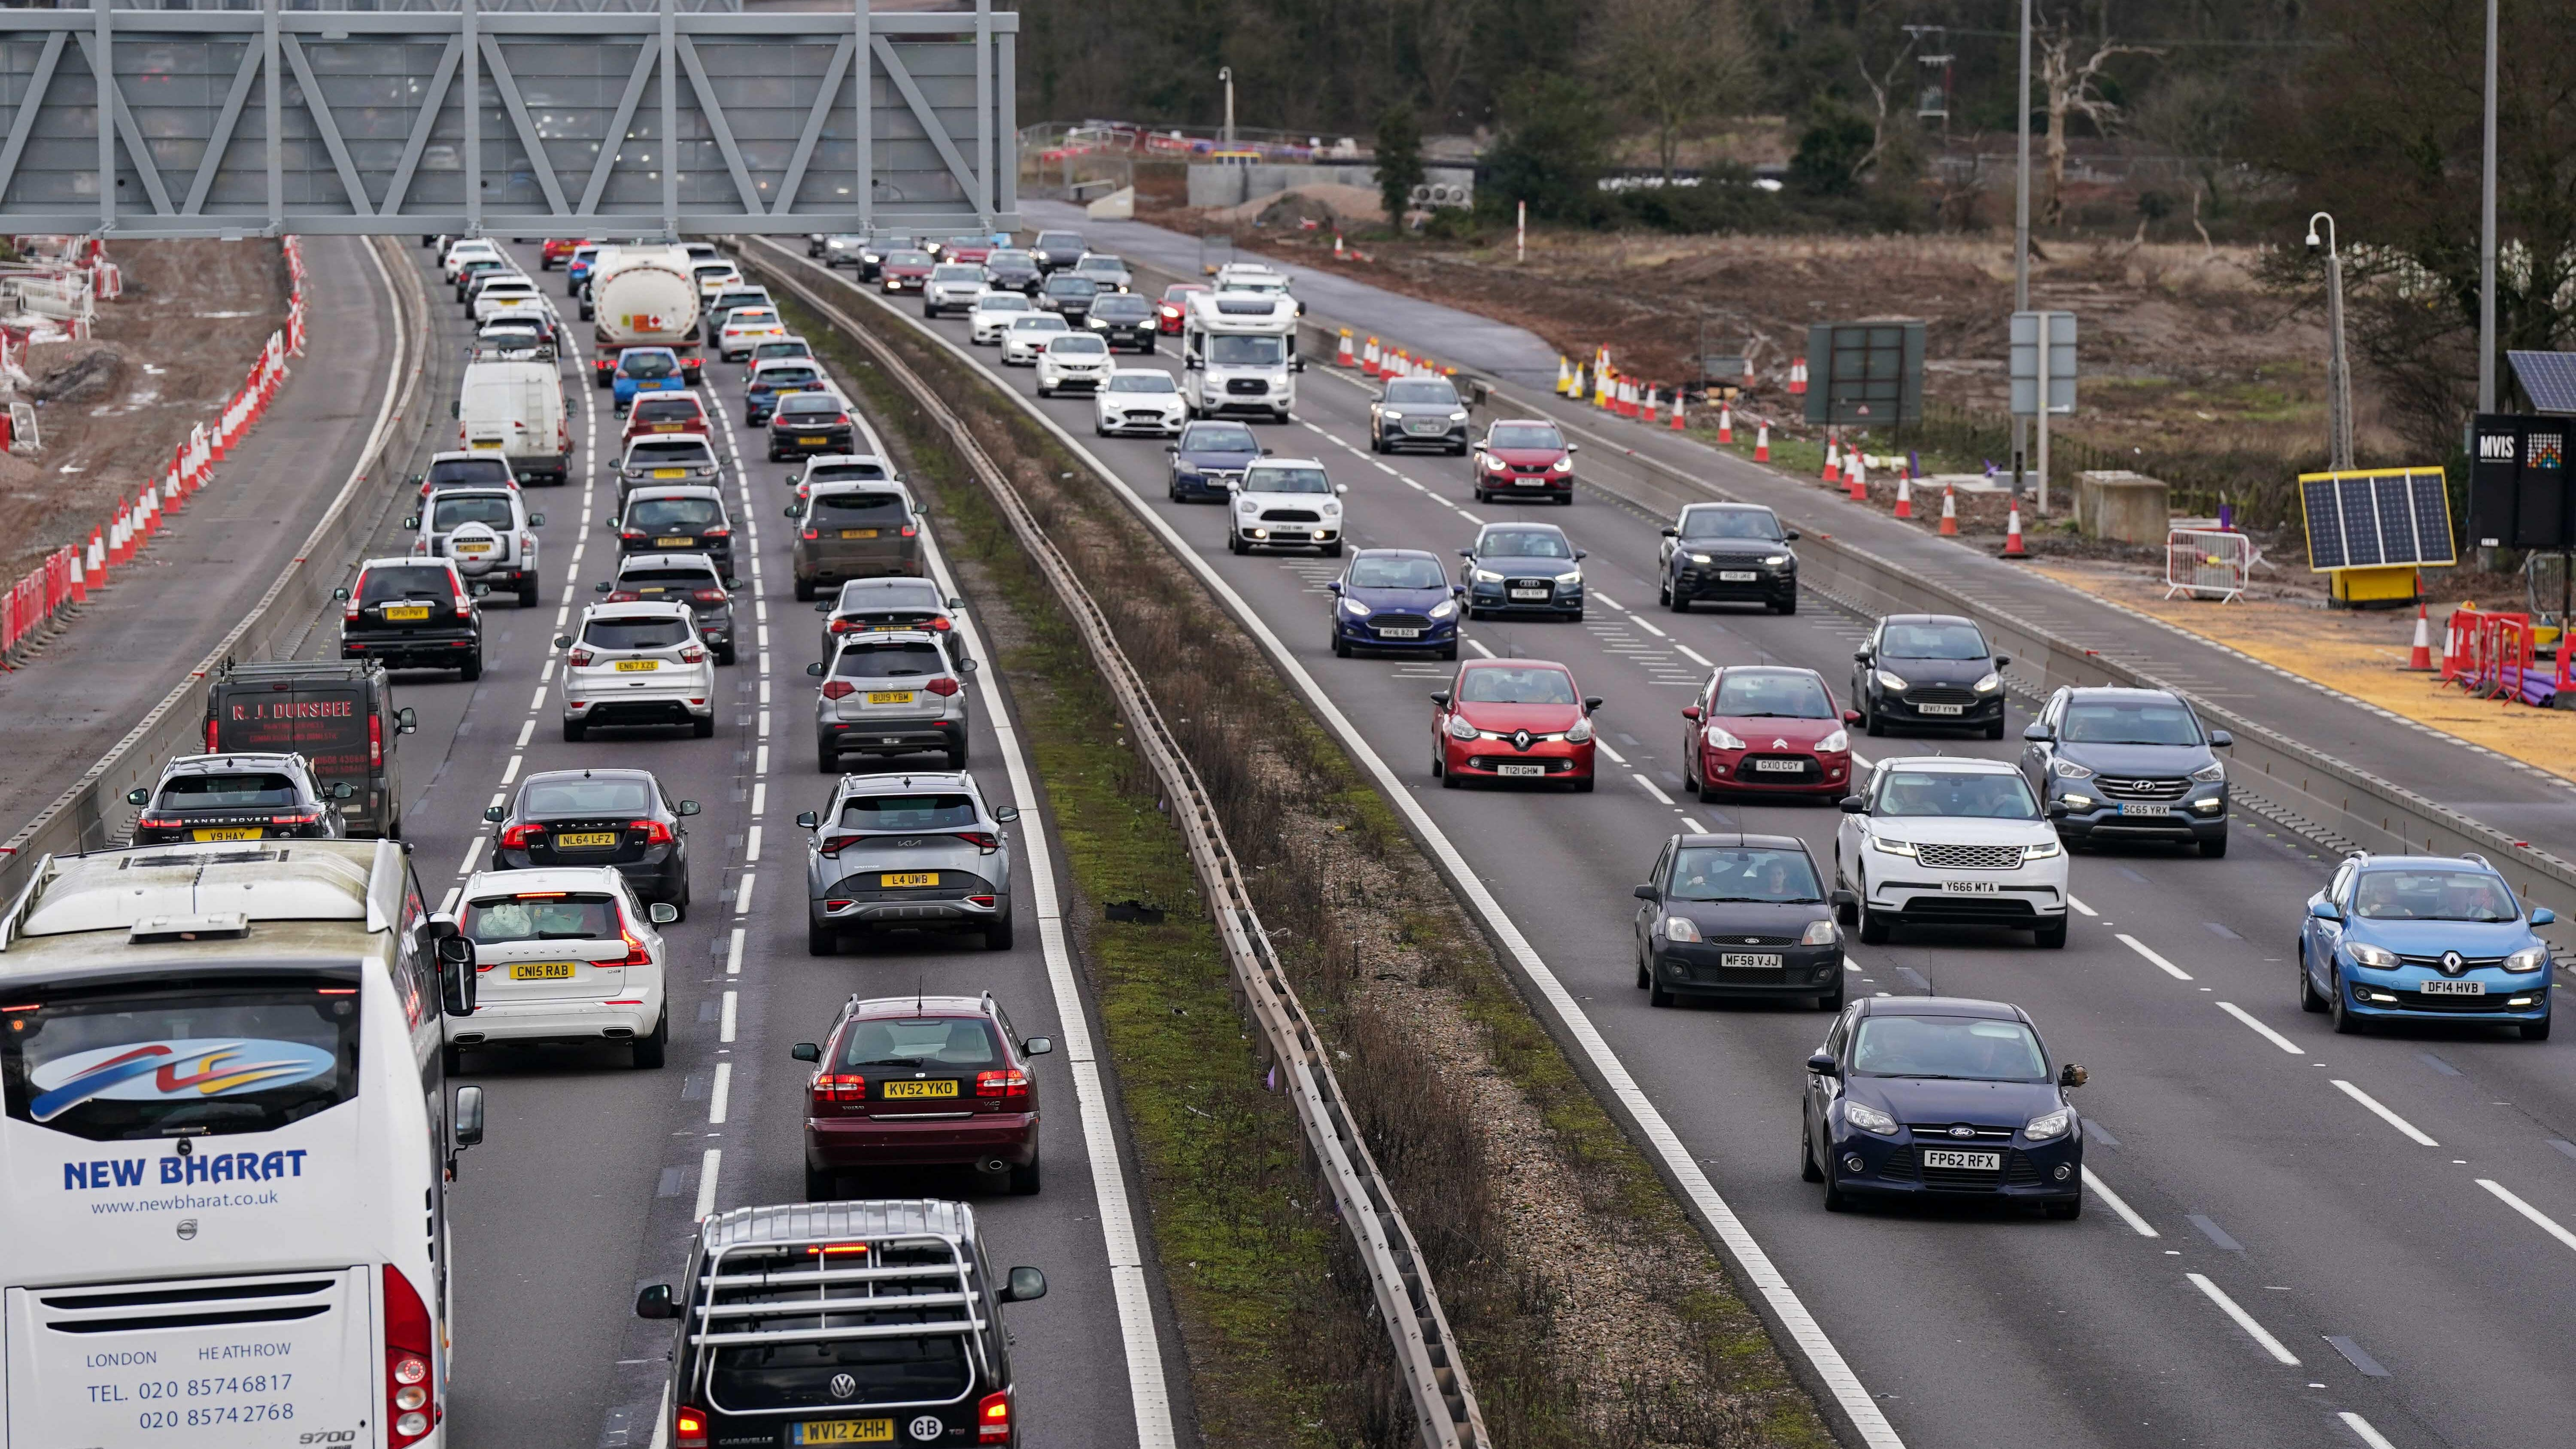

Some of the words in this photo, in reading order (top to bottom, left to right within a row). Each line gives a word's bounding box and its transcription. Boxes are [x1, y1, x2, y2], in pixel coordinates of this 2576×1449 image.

[2480, 435, 2515, 459] MVIS
[873, 693, 890, 702] BU19
[893, 693, 909, 701] YBM
[273, 701, 352, 719] DUNSBEE
[2123, 805, 2148, 814] SC65
[2151, 806, 2168, 815] YRX
[210, 832, 223, 841] V9
[226, 832, 245, 840] HAY
[563, 836, 589, 845] NL64
[591, 834, 611, 844] LFZ
[893, 876, 905, 884] L4
[908, 875, 928, 884] UWB
[1947, 882, 1972, 892] Y666
[1975, 883, 1995, 893] MTA
[1726, 955, 1754, 966] MF58
[1757, 956, 1778, 966] VJJ
[518, 965, 543, 977] CN15
[546, 965, 569, 976] RAB
[2428, 981, 2453, 993] DF14
[2457, 983, 2478, 993] HVB
[890, 1083, 923, 1095] KV52
[927, 1082, 952, 1094] YKO
[1930, 1153, 1964, 1166] FP62
[1968, 1154, 1994, 1168] RFX
[64, 1159, 146, 1190] NEW
[160, 1149, 307, 1186] BHARAT
[91, 1190, 278, 1214] www.newbharat.co.uk
[87, 1351, 157, 1368] LONDON
[199, 1343, 292, 1360] HEATHROW
[88, 1385, 128, 1402] TEL.
[140, 1381, 178, 1400] 020
[140, 1410, 179, 1429] 020
[809, 1422, 848, 1441] WV12
[852, 1420, 886, 1438] ZHH
[914, 1420, 938, 1436] GB
[300, 1431, 356, 1444] 9700
[719, 1437, 774, 1445] CARAVELLE
